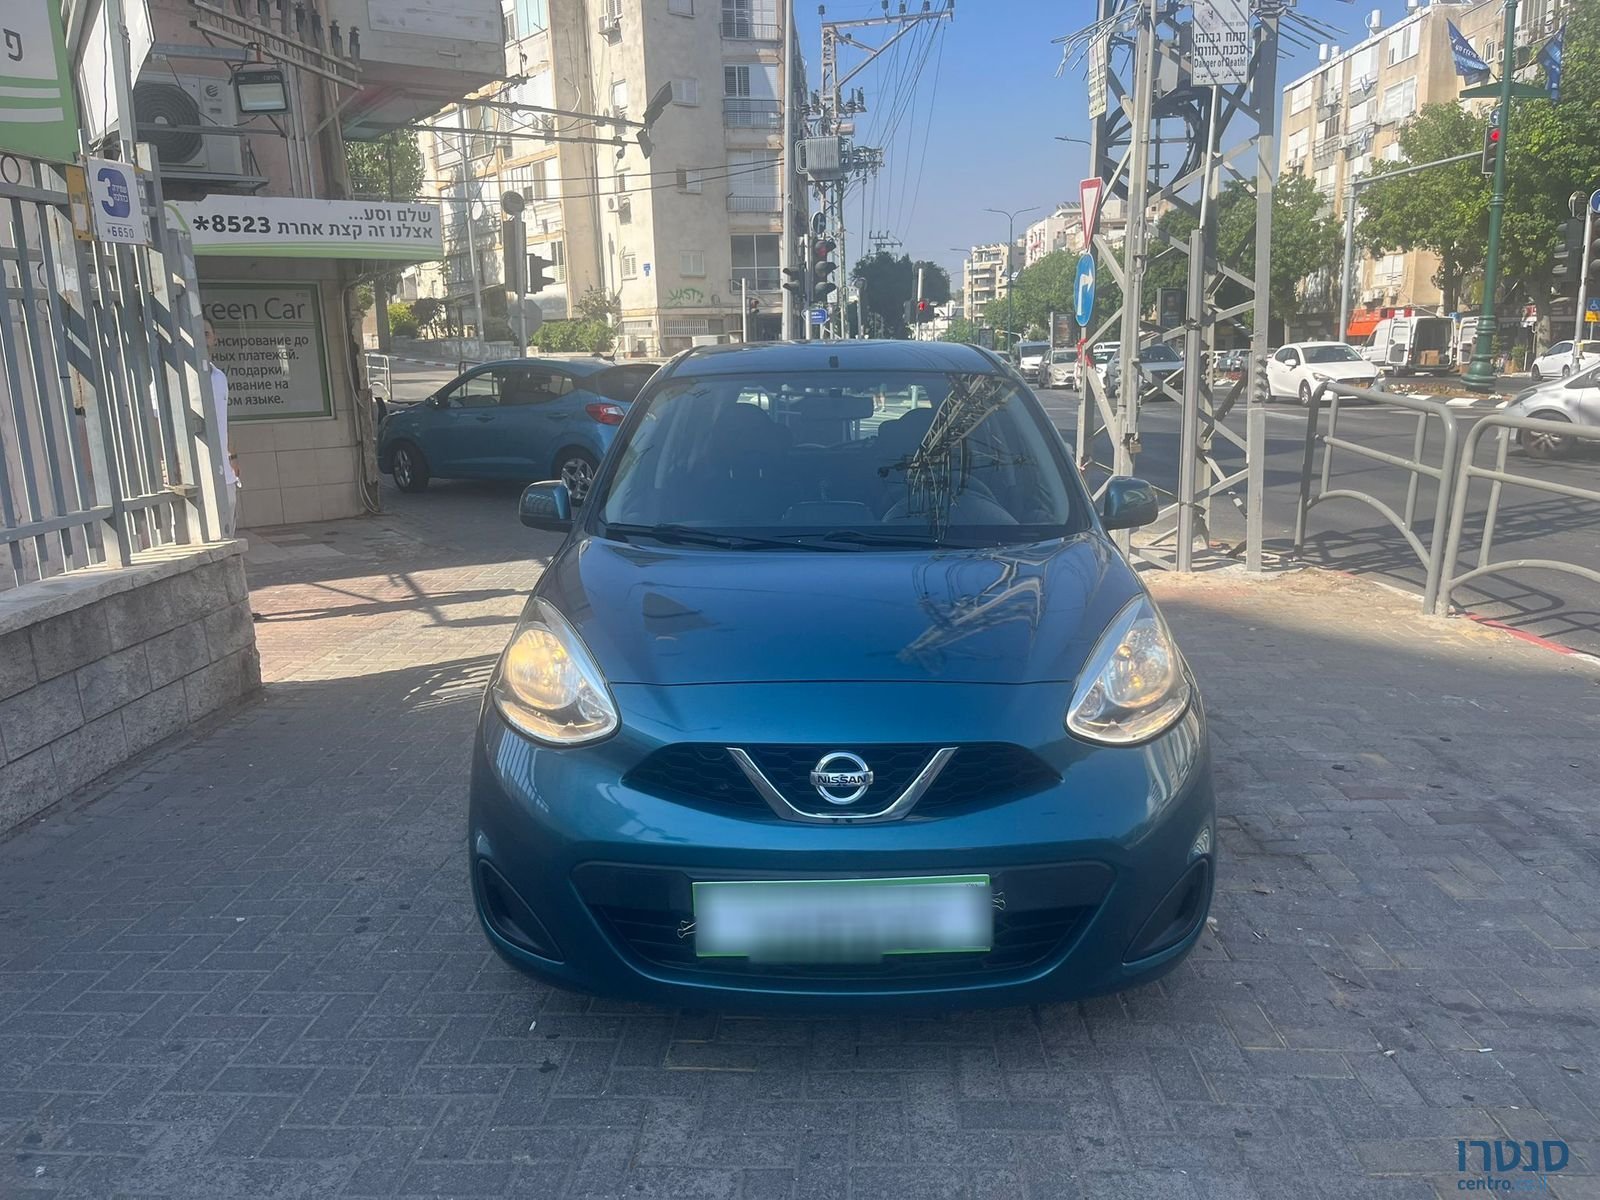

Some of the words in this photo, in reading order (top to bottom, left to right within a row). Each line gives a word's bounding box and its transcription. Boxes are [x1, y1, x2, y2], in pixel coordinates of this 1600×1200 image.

[1195, 32, 1221, 43] גבוה!
[1225, 32, 1246, 42] מתח
[1222, 45, 1246, 55] סכנת
[349, 208, 392, 221] וסע...
[398, 207, 432, 223] שלם
[277, 221, 322, 236] אחרת
[329, 223, 363, 240] קצת
[368, 224, 386, 238] זה
[391, 223, 433, 239] אצלנו
[201, 302, 258, 320] reen
[264, 297, 306, 320] Car
[215, 336, 291, 349] нсирование
[294, 335, 309, 346] до
[211, 352, 236, 361] ных
[238, 348, 300, 361] платежей.
[228, 381, 272, 391] ивание
[275, 380, 289, 389] на
[227, 397, 243, 406] ом
[245, 395, 284, 405] языке.
[817, 775, 866, 784] NISSAN
